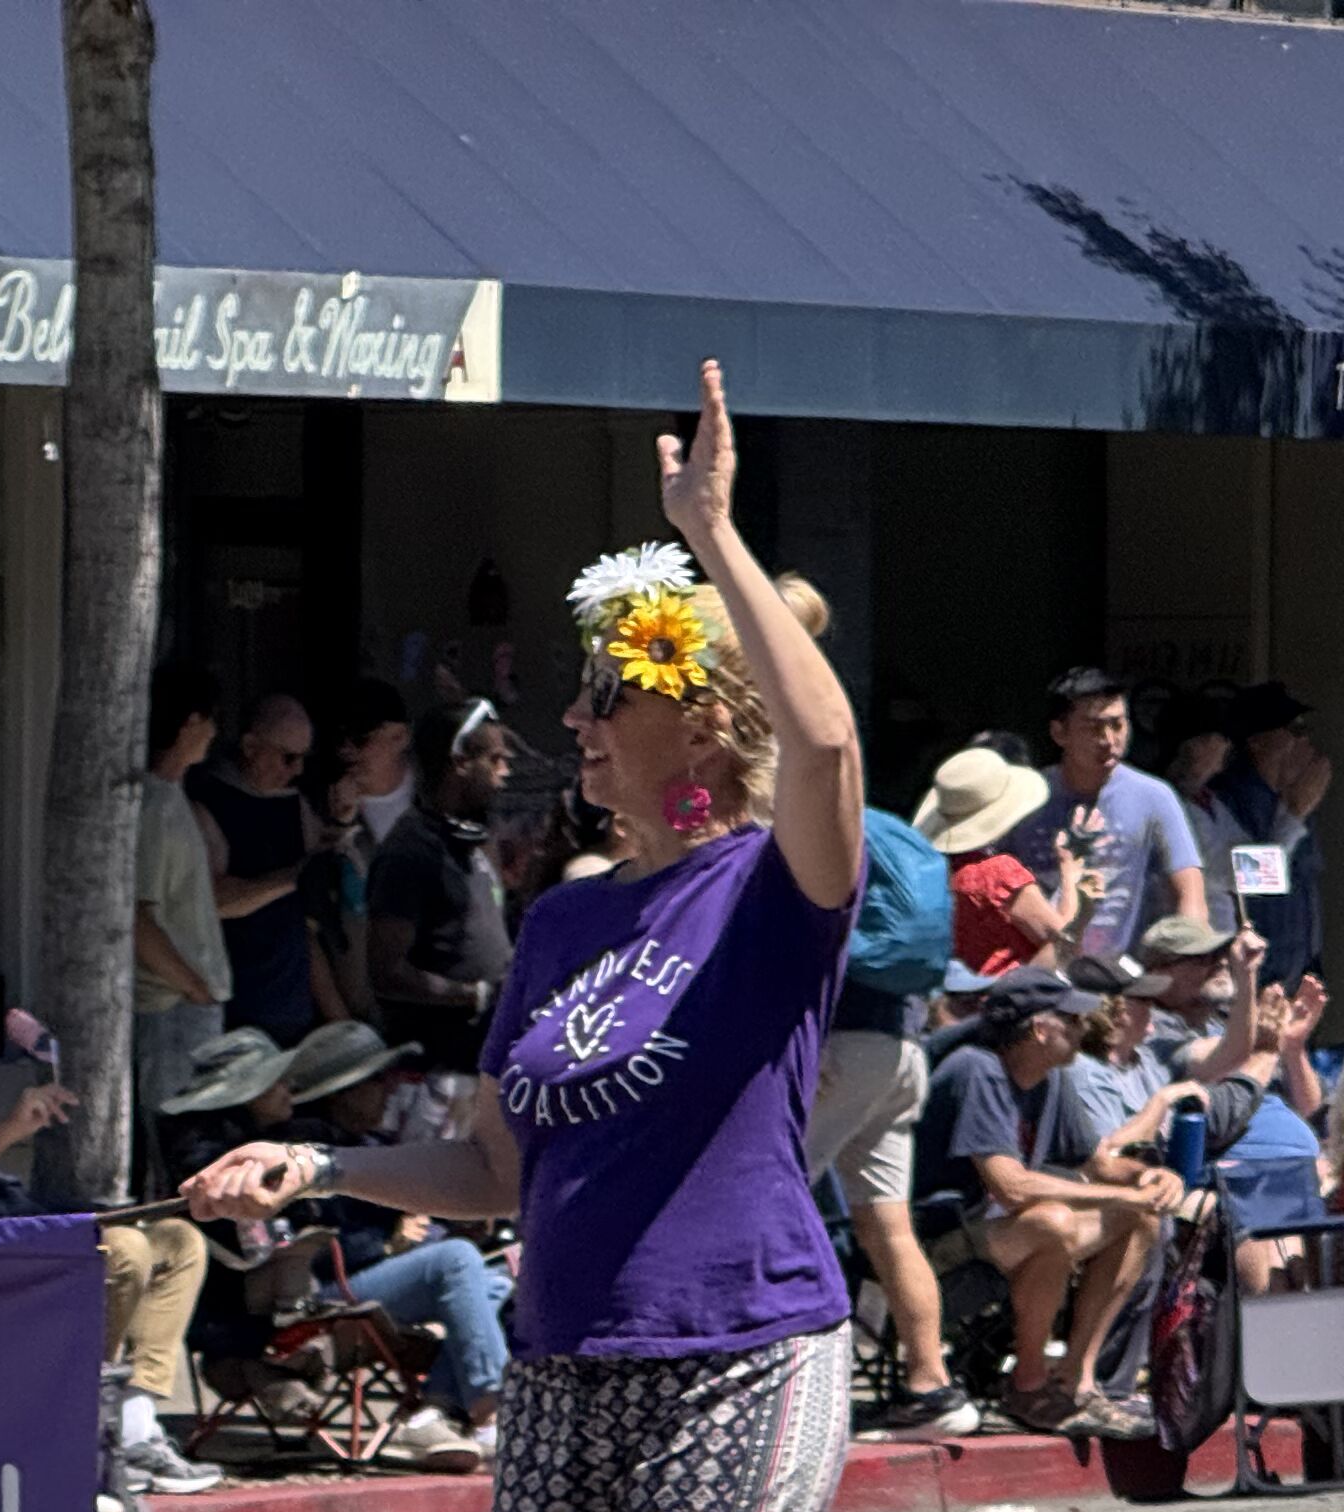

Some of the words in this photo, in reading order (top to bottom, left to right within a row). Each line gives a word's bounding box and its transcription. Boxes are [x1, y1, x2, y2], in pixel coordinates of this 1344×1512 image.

[155, 281, 206, 369] ail
[205, 293, 275, 388] Spa
[284, 287, 317, 374] &
[319, 296, 443, 399] Waxing
[499, 1030, 691, 1126] COALITION
